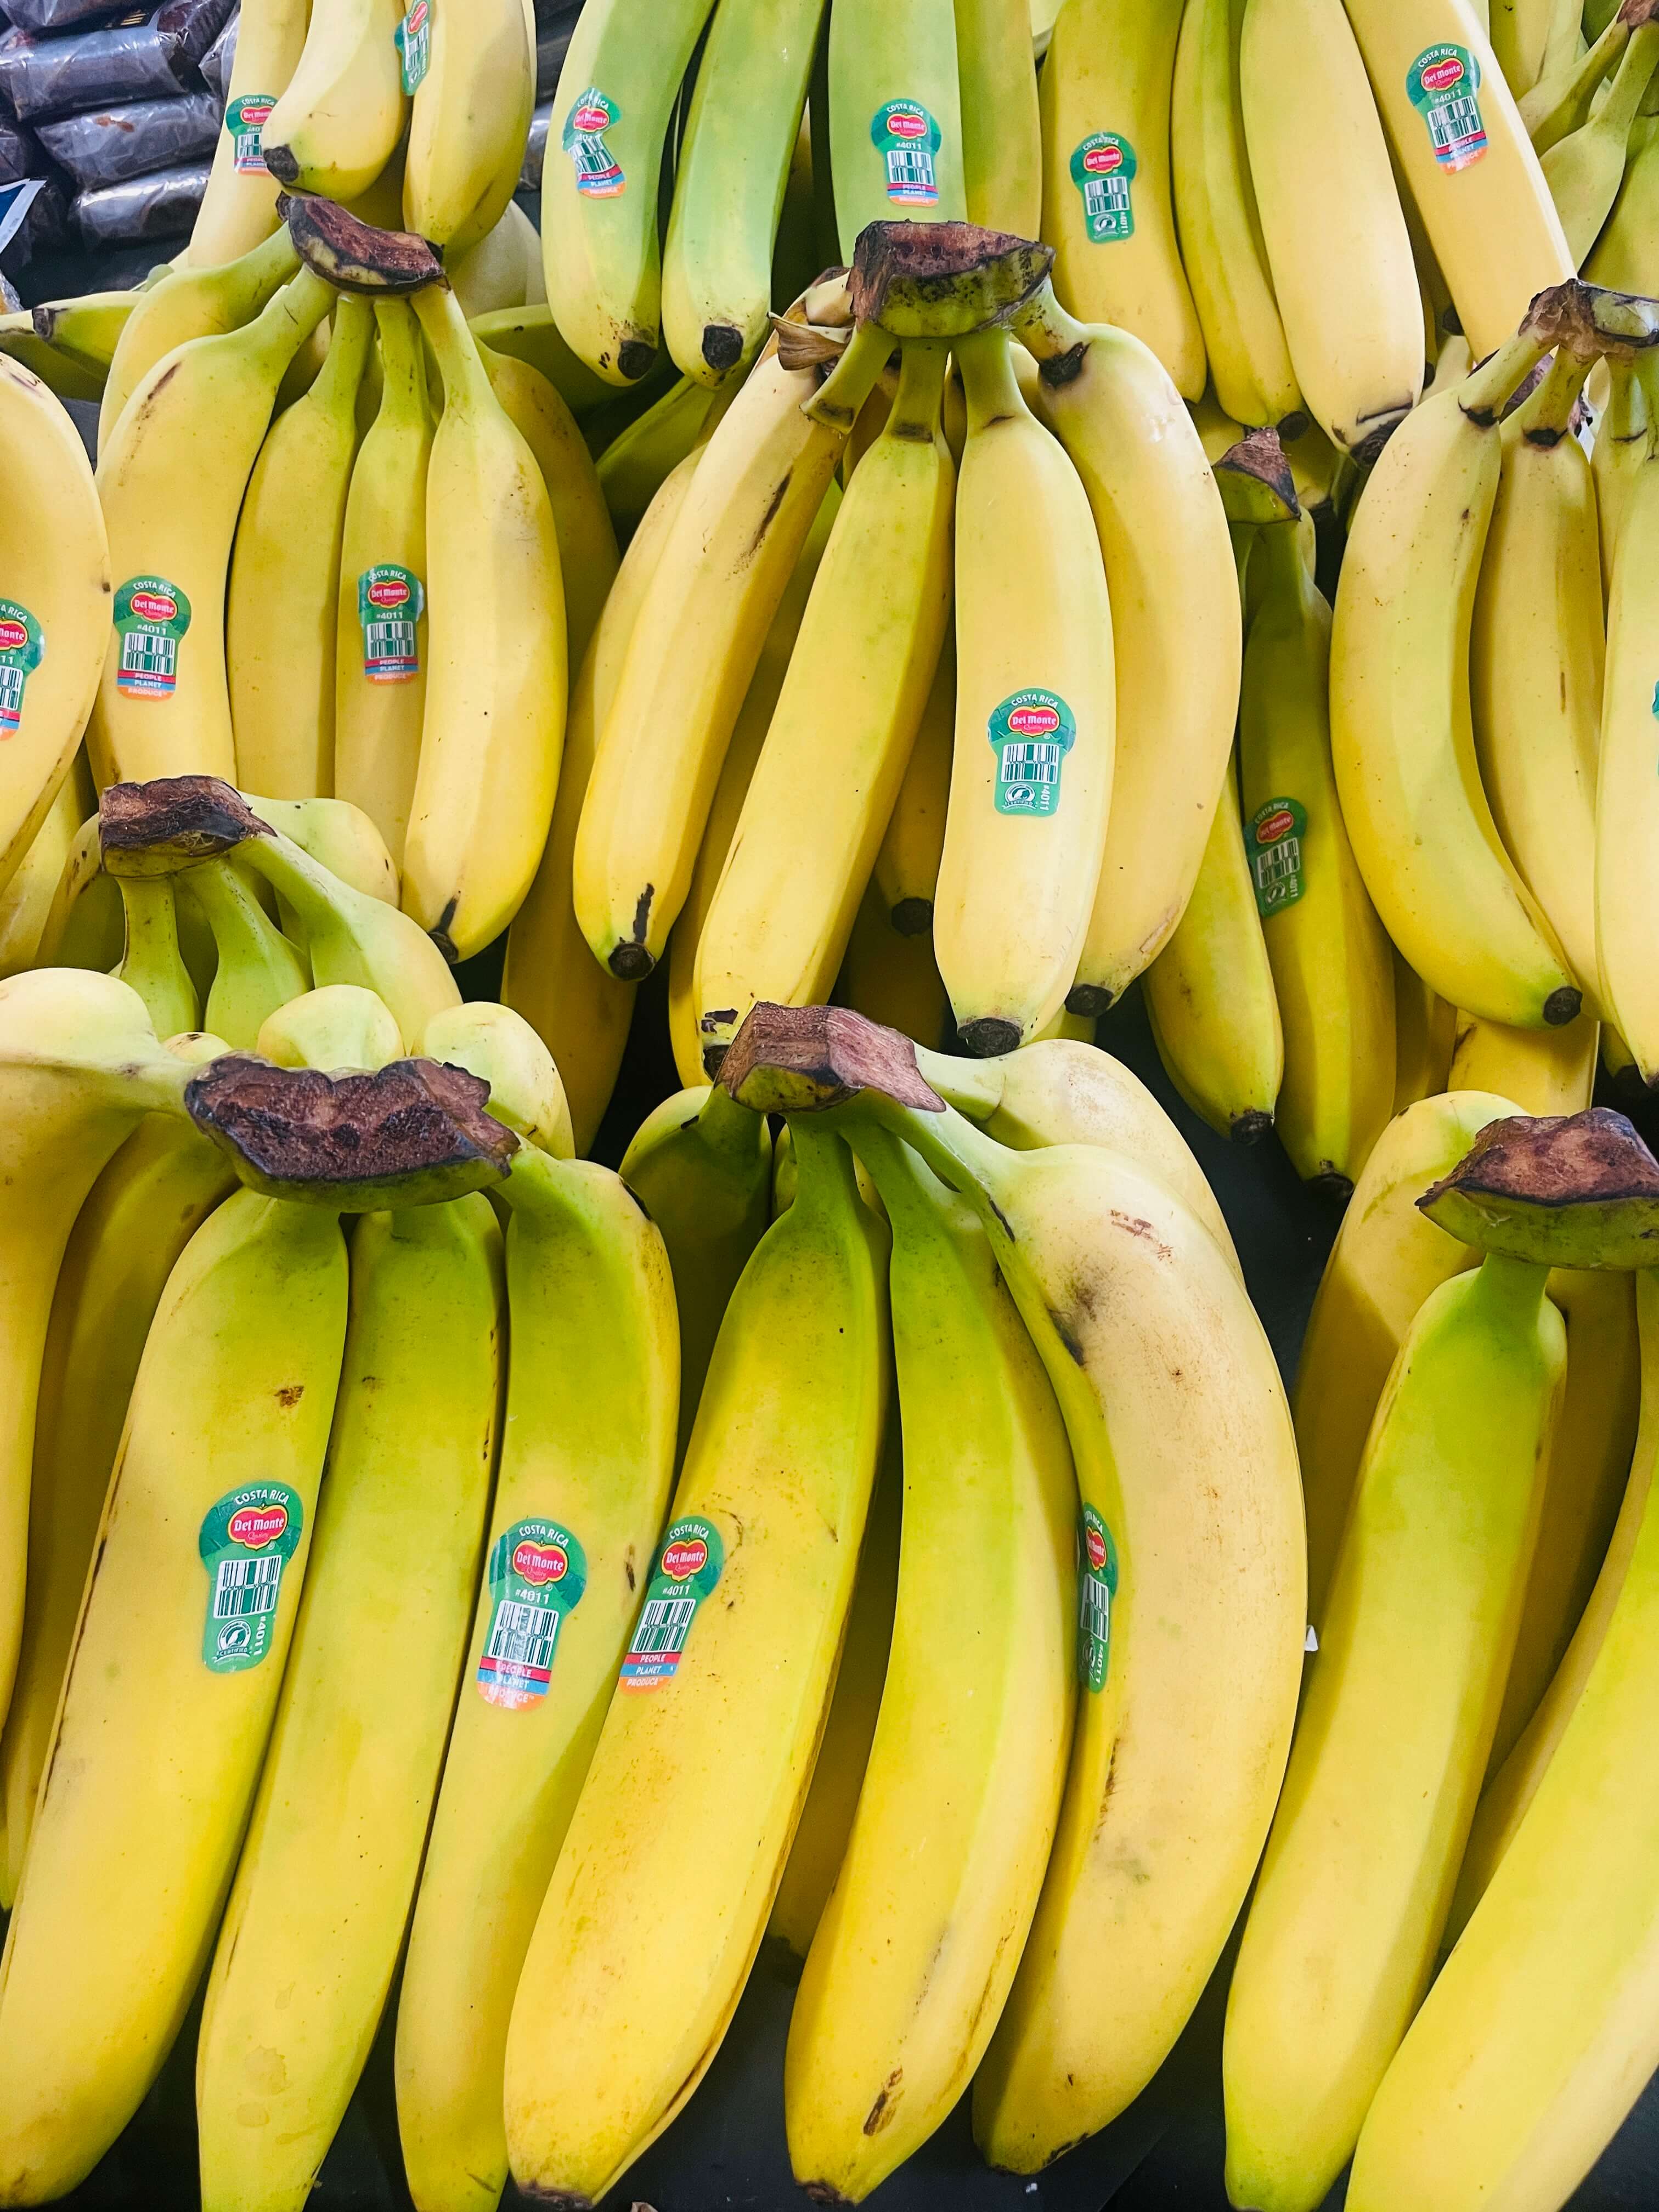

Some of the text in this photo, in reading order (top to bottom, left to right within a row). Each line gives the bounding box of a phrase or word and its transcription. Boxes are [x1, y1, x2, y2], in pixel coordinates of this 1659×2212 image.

[1418, 48, 1457, 67] COSTA RICA
[1424, 75, 1437, 84] Del
[1437, 65, 1460, 80] Monte
[1435, 89, 1462, 104] #4011
[887, 103, 924, 117] COSTA RICA
[368, 569, 407, 582] COSTA RICA
[133, 581, 176, 598] COSTA RICA
[371, 589, 407, 598] Del Monte
[8, 606, 27, 623] RICA
[134, 600, 174, 614] Del Monte
[138, 624, 166, 635] #4011
[135, 673, 162, 681] PEOPLE
[135, 680, 162, 688] PLANET
[1011, 694, 1058, 709] COSTA RICA
[1012, 715, 1057, 725] Del Monte
[1040, 785, 1049, 810] #4011
[234, 1489, 290, 1505] COSTA RICA
[234, 1517, 284, 1532] Del Monte
[669, 1524, 709, 1540] COSTA RICA
[519, 1525, 569, 1548] COSTA RICA
[517, 1551, 563, 1571] Del Monte
[666, 1551, 705, 1564] Del Monte
[515, 1588, 550, 1605] #4011
[663, 1584, 690, 1596] #4011
[253, 1616, 266, 1655] #4011
[640, 1654, 667, 1663] PEOPLE
[636, 1666, 662, 1675] PLANET
[627, 1676, 659, 1687] PRODUCE
